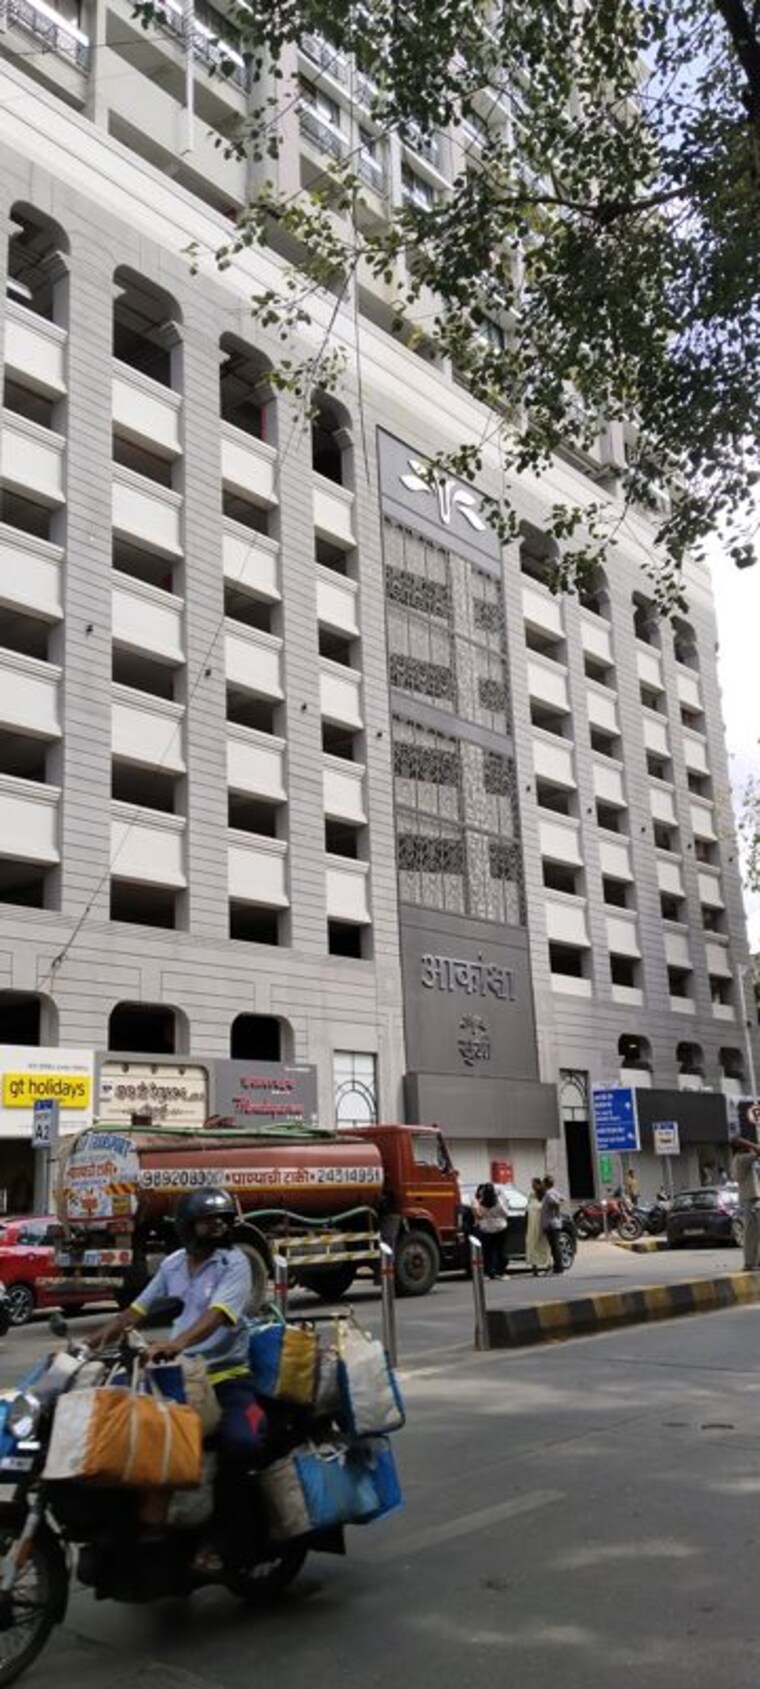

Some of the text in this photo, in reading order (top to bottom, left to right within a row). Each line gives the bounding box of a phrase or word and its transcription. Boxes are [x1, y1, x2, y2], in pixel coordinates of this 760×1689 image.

[10, 1079, 24, 1098] gt
[29, 1078, 85, 1099] holidays
[35, 1125, 50, 1140] A2
